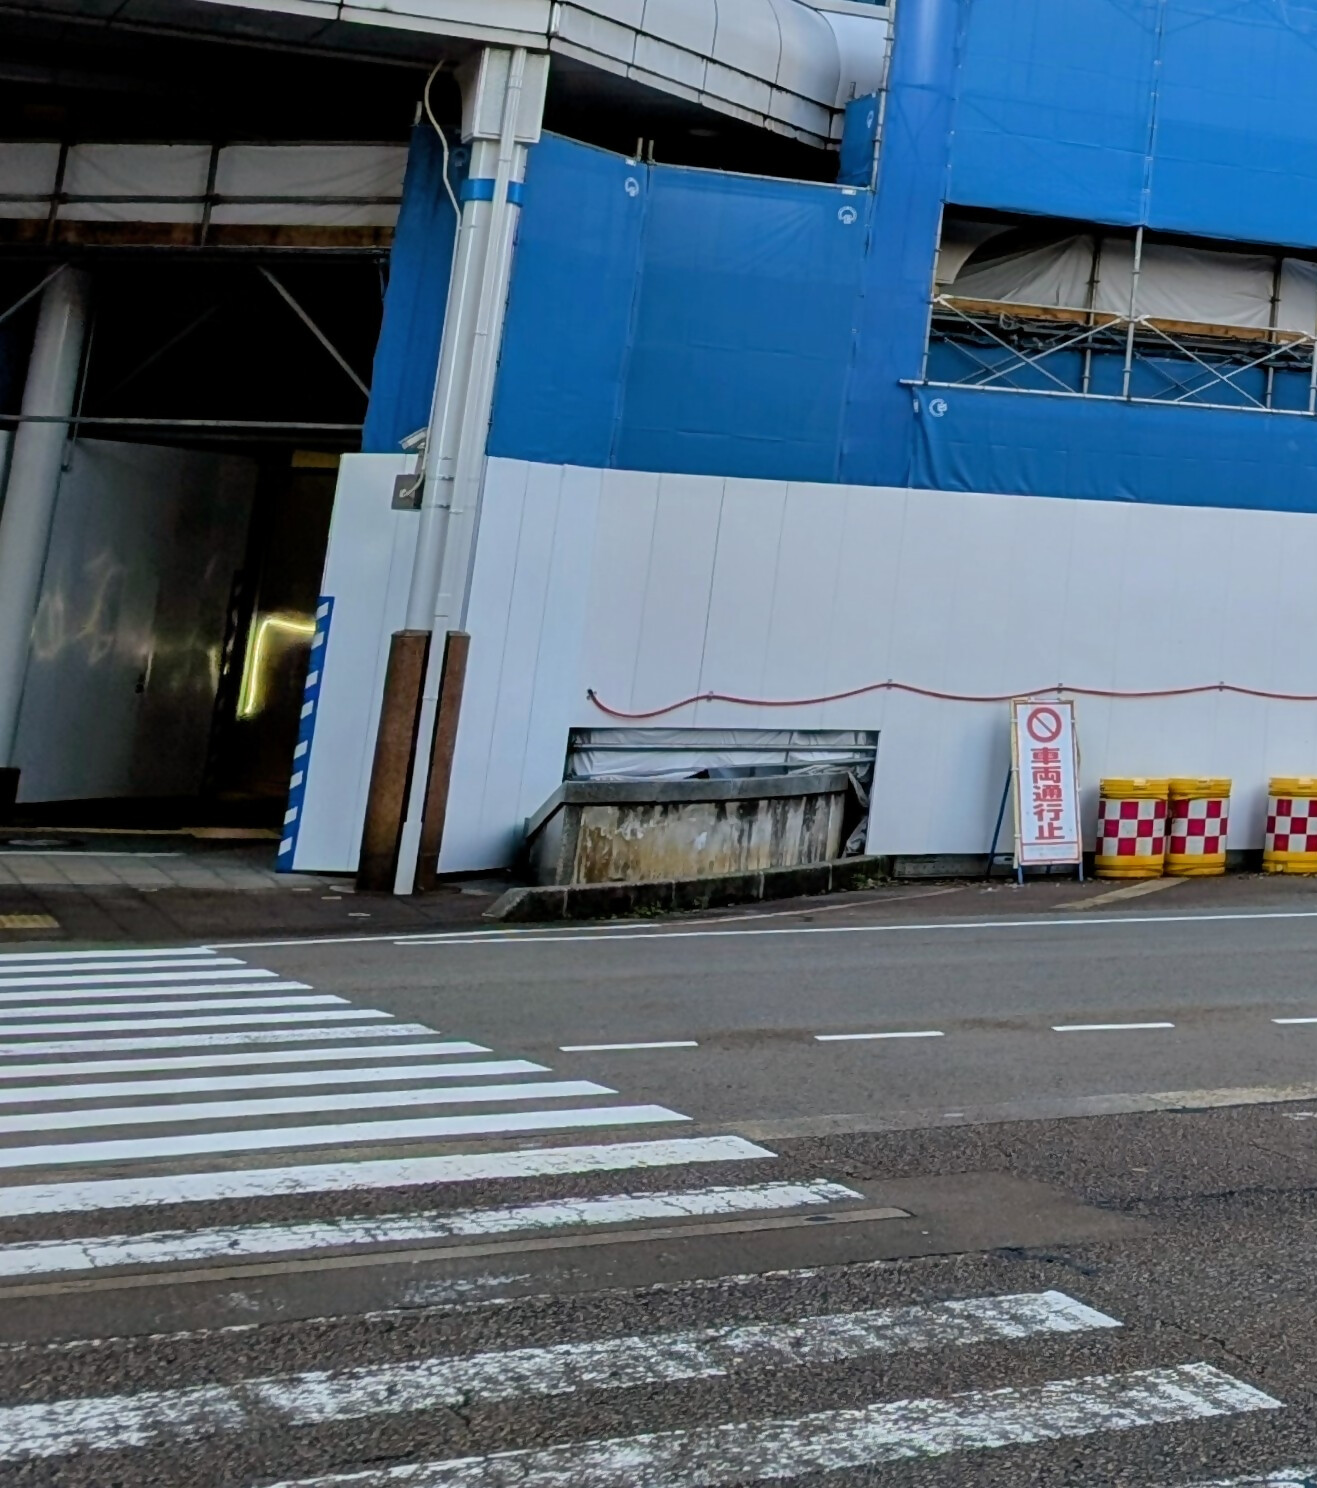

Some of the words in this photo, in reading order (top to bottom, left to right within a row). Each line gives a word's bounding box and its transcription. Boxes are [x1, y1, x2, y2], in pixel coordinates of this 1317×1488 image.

[1030, 746, 1066, 840] 車両通行止
